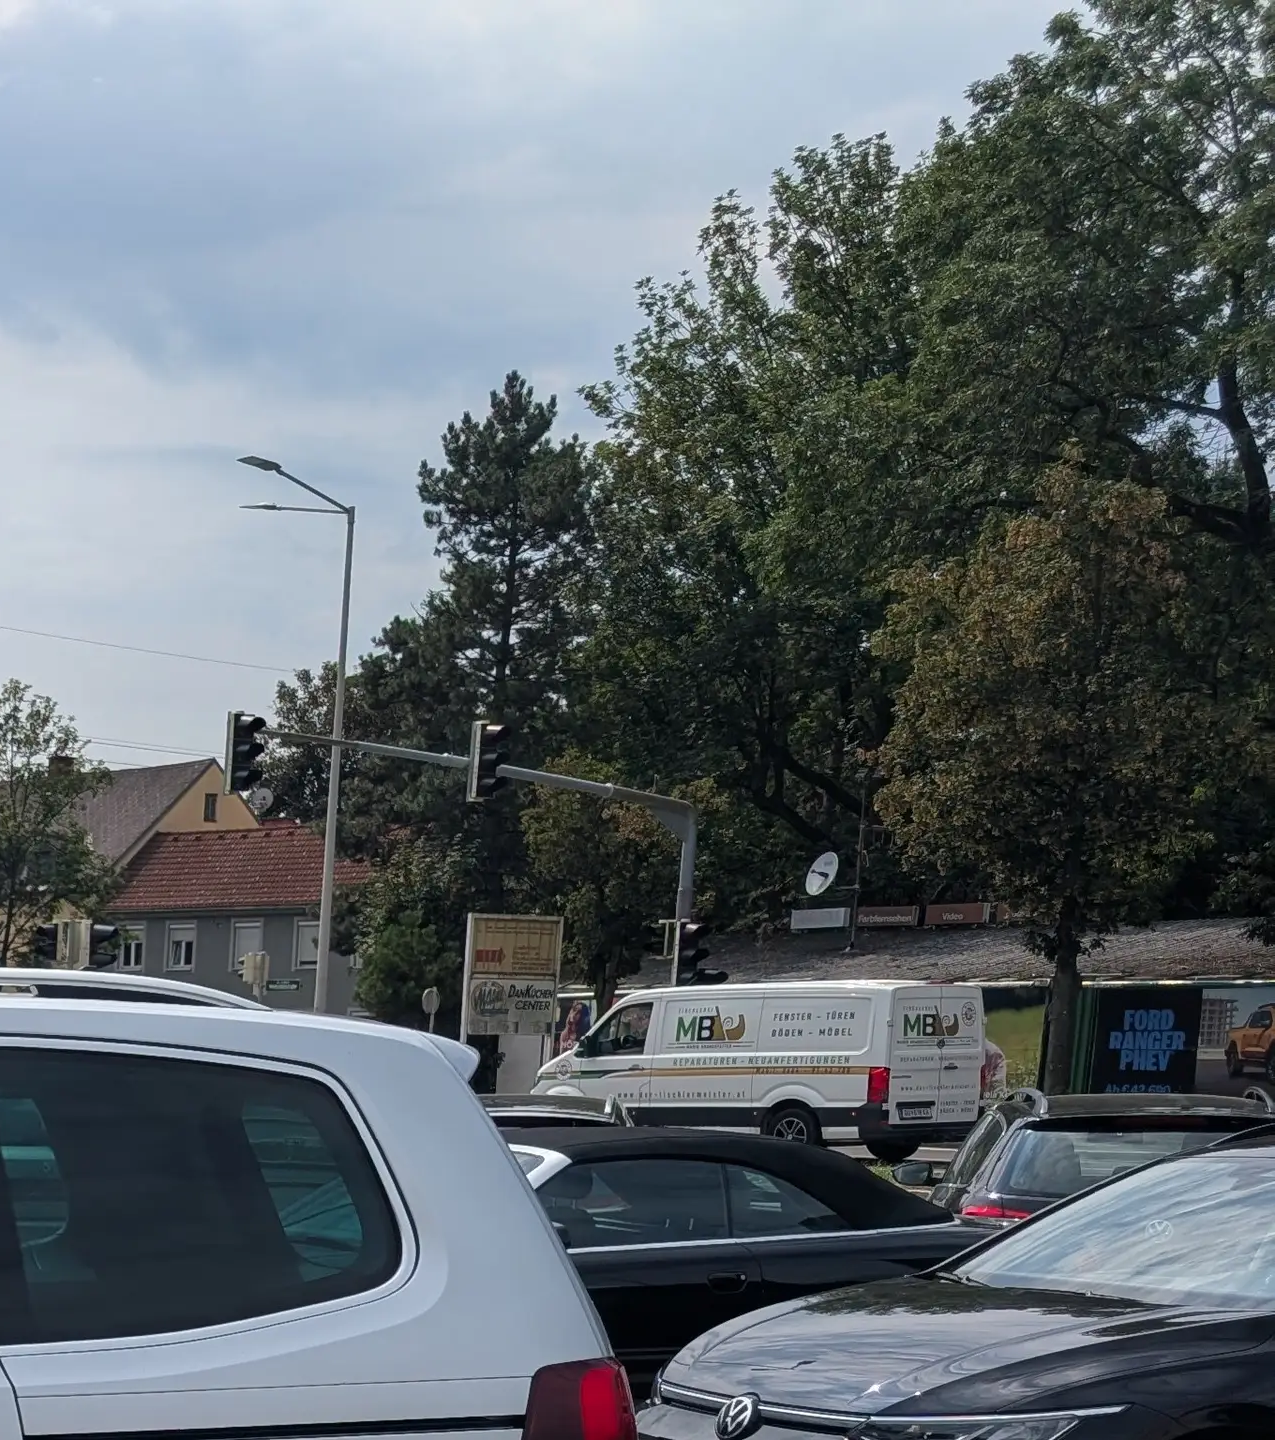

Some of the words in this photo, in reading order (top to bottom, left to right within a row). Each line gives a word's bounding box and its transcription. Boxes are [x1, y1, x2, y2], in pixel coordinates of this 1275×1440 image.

[942, 912, 964, 921] Video
[515, 1001, 551, 1011] CENTER
[773, 1012, 812, 1021] FENSTER
[826, 1010, 856, 1020] TÜREN
[1123, 1009, 1176, 1031] FORD
[819, 1026, 853, 1036] MÖBEL
[1109, 1031, 1186, 1050] RANGER
[673, 1057, 738, 1067] REPARATUREN
[748, 1056, 850, 1065] NEUANFERTIGUNGEN
[1119, 1050, 1173, 1071] PHEV
